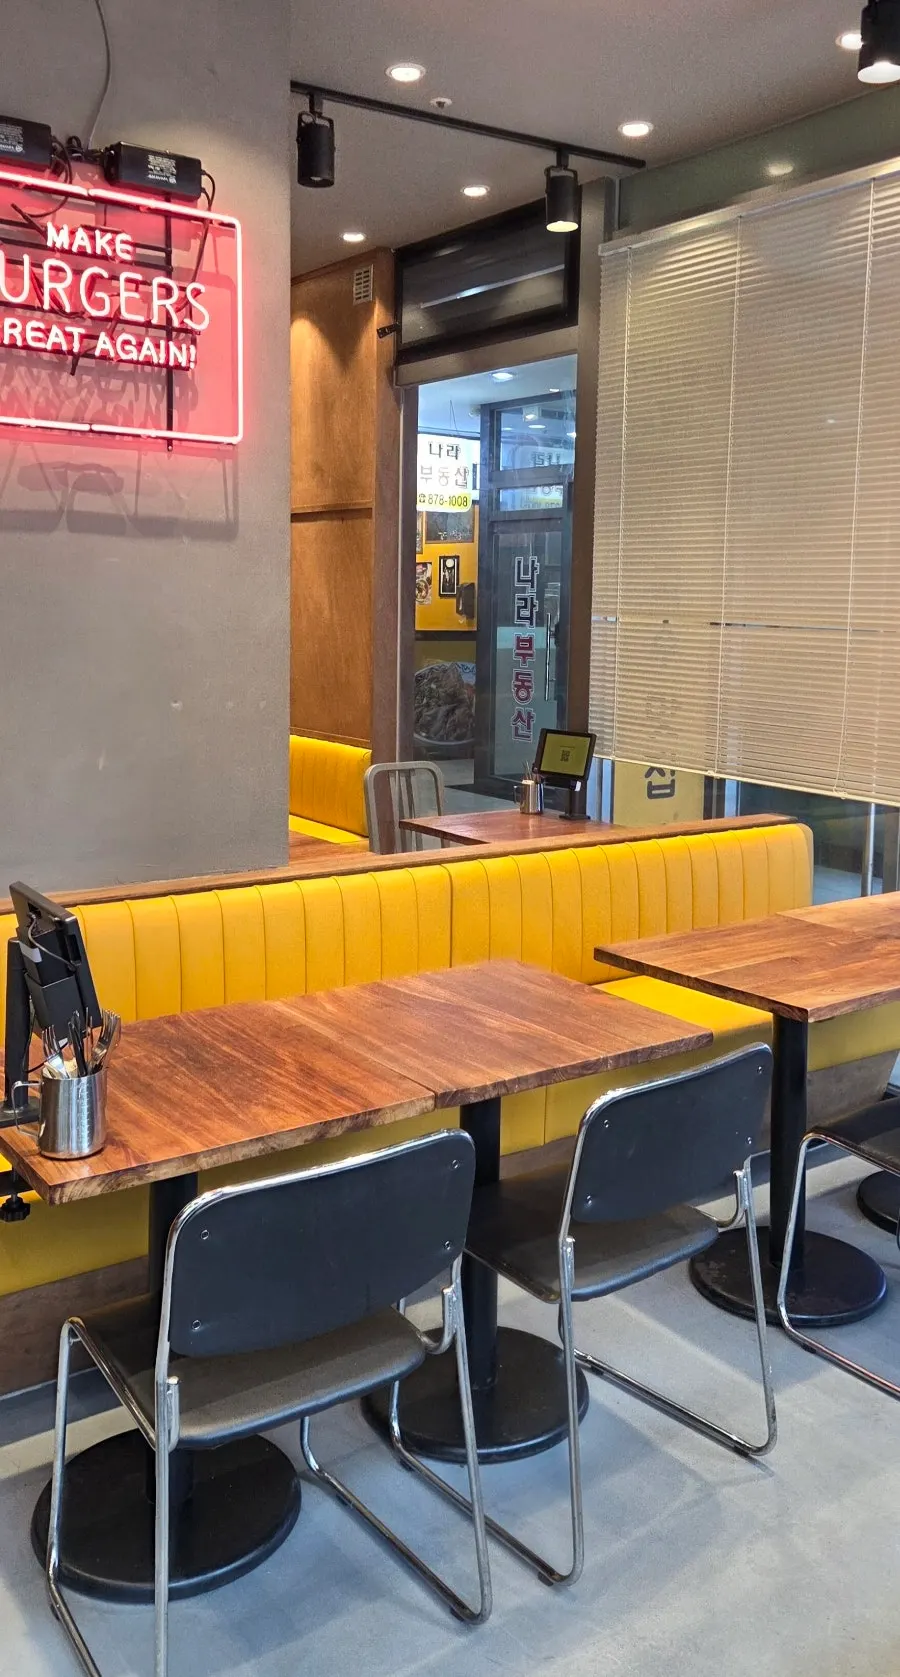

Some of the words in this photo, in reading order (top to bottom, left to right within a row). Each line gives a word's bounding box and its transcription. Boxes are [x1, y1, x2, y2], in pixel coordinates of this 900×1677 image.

[46, 221, 133, 261] MAKE
[0, 252, 210, 331] URGERS
[94, 331, 197, 369] AGAIN!
[428, 442, 461, 460] 나라
[420, 465, 469, 489] 부동산
[427, 493, 468, 507] 878-1008
